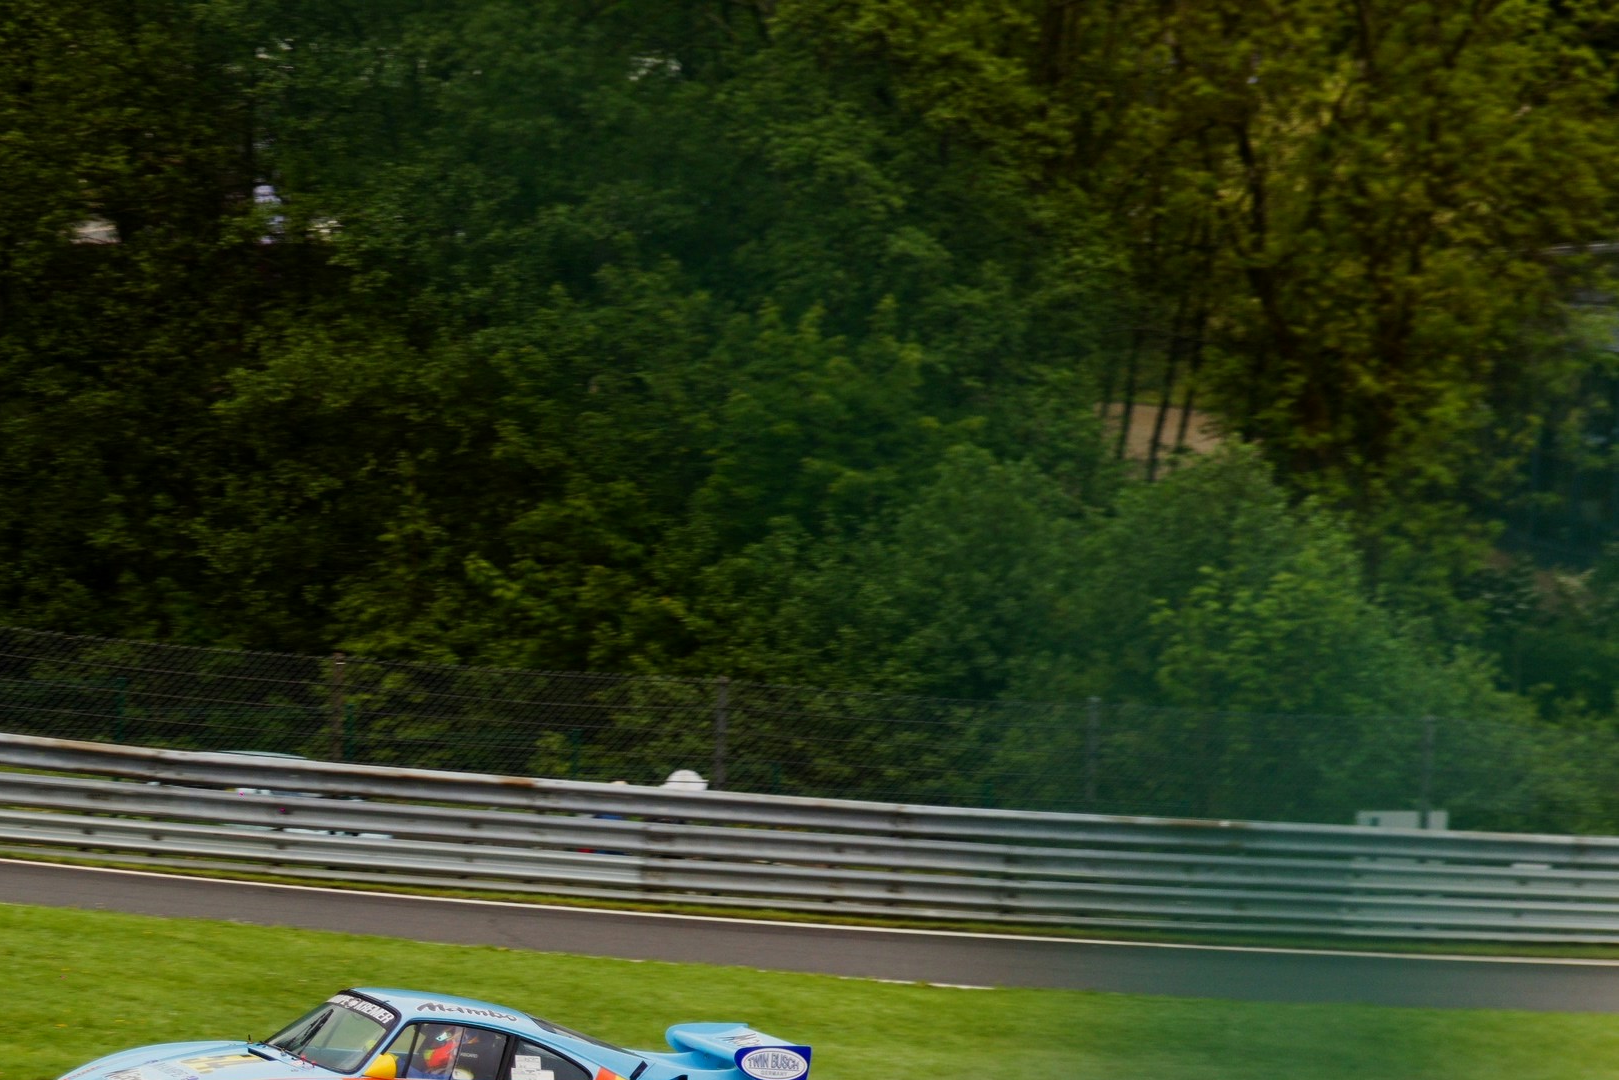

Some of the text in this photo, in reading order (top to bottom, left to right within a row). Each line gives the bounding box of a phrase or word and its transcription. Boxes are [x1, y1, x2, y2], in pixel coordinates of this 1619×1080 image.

[354, 1000, 395, 1024] KREMER
[417, 1002, 517, 1022] Mambo
[748, 1053, 800, 1070] TWIN BUSCH
